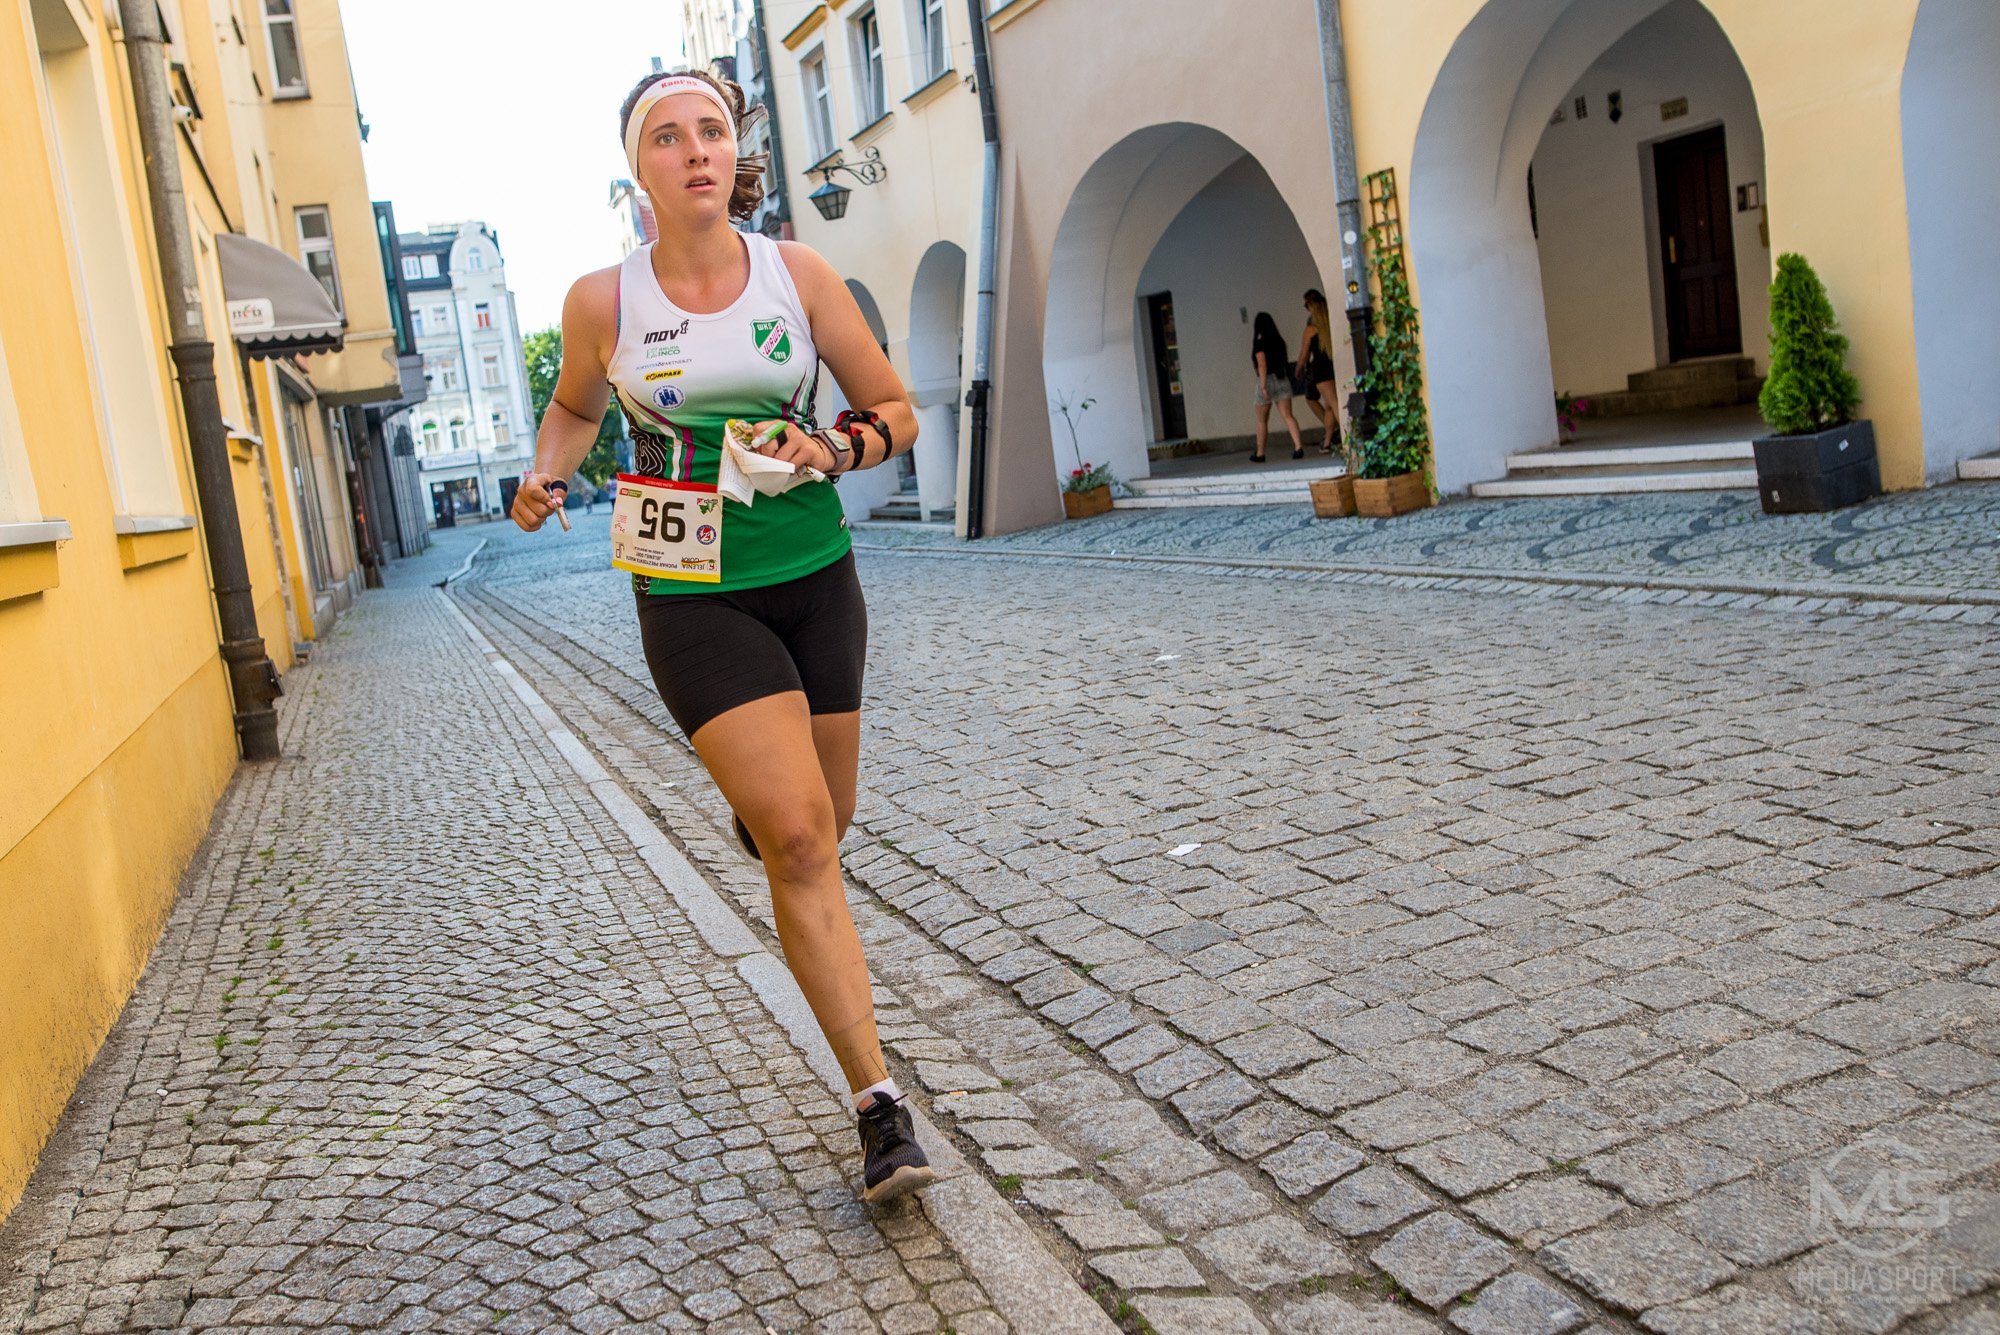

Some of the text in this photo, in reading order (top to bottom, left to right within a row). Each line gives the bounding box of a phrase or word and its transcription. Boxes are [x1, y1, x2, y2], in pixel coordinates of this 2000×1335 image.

[757, 322, 773, 331] WKS
[658, 349, 681, 357] INCO
[645, 370, 682, 381] COMPASS
[638, 498, 686, 543] 95
